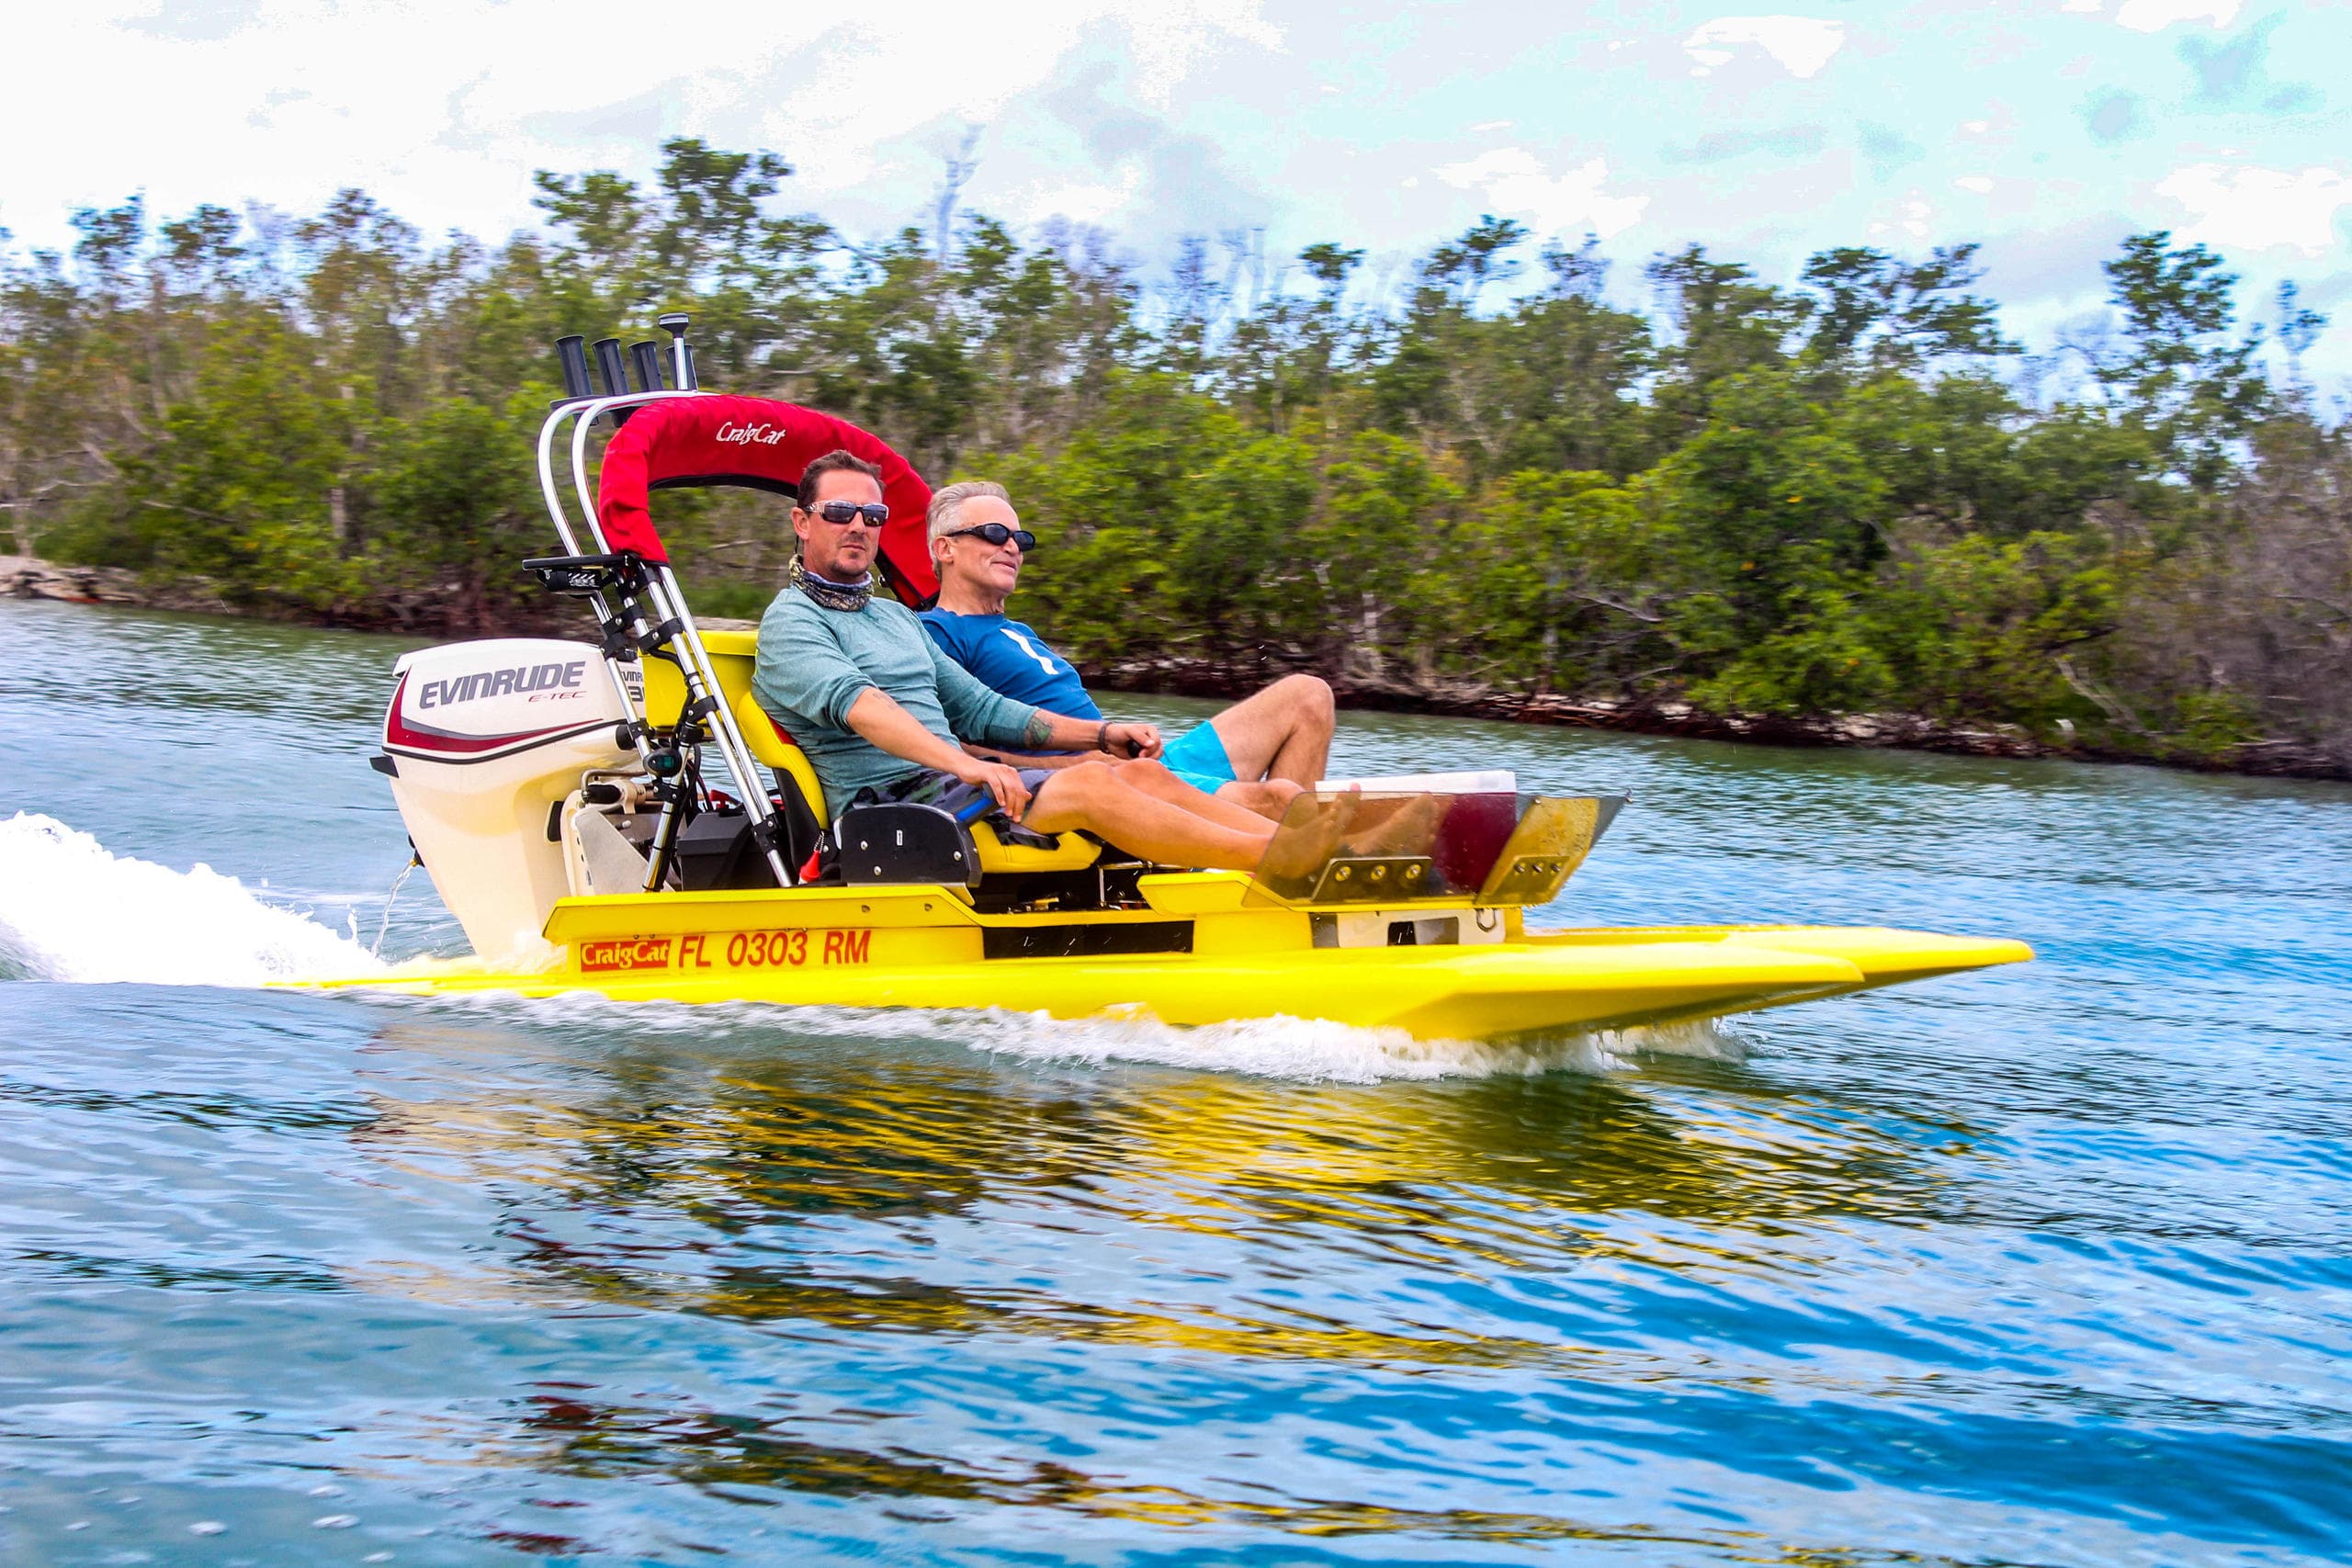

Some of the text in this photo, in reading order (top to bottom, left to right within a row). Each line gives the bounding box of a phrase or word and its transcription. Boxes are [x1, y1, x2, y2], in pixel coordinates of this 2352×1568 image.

[716, 421, 786, 446] CraigCat
[420, 661, 586, 709] EVINRUDE
[528, 691, 585, 703] E-TEC
[582, 940, 669, 970] CraigCat
[678, 929, 871, 969] FL 0303 RM
